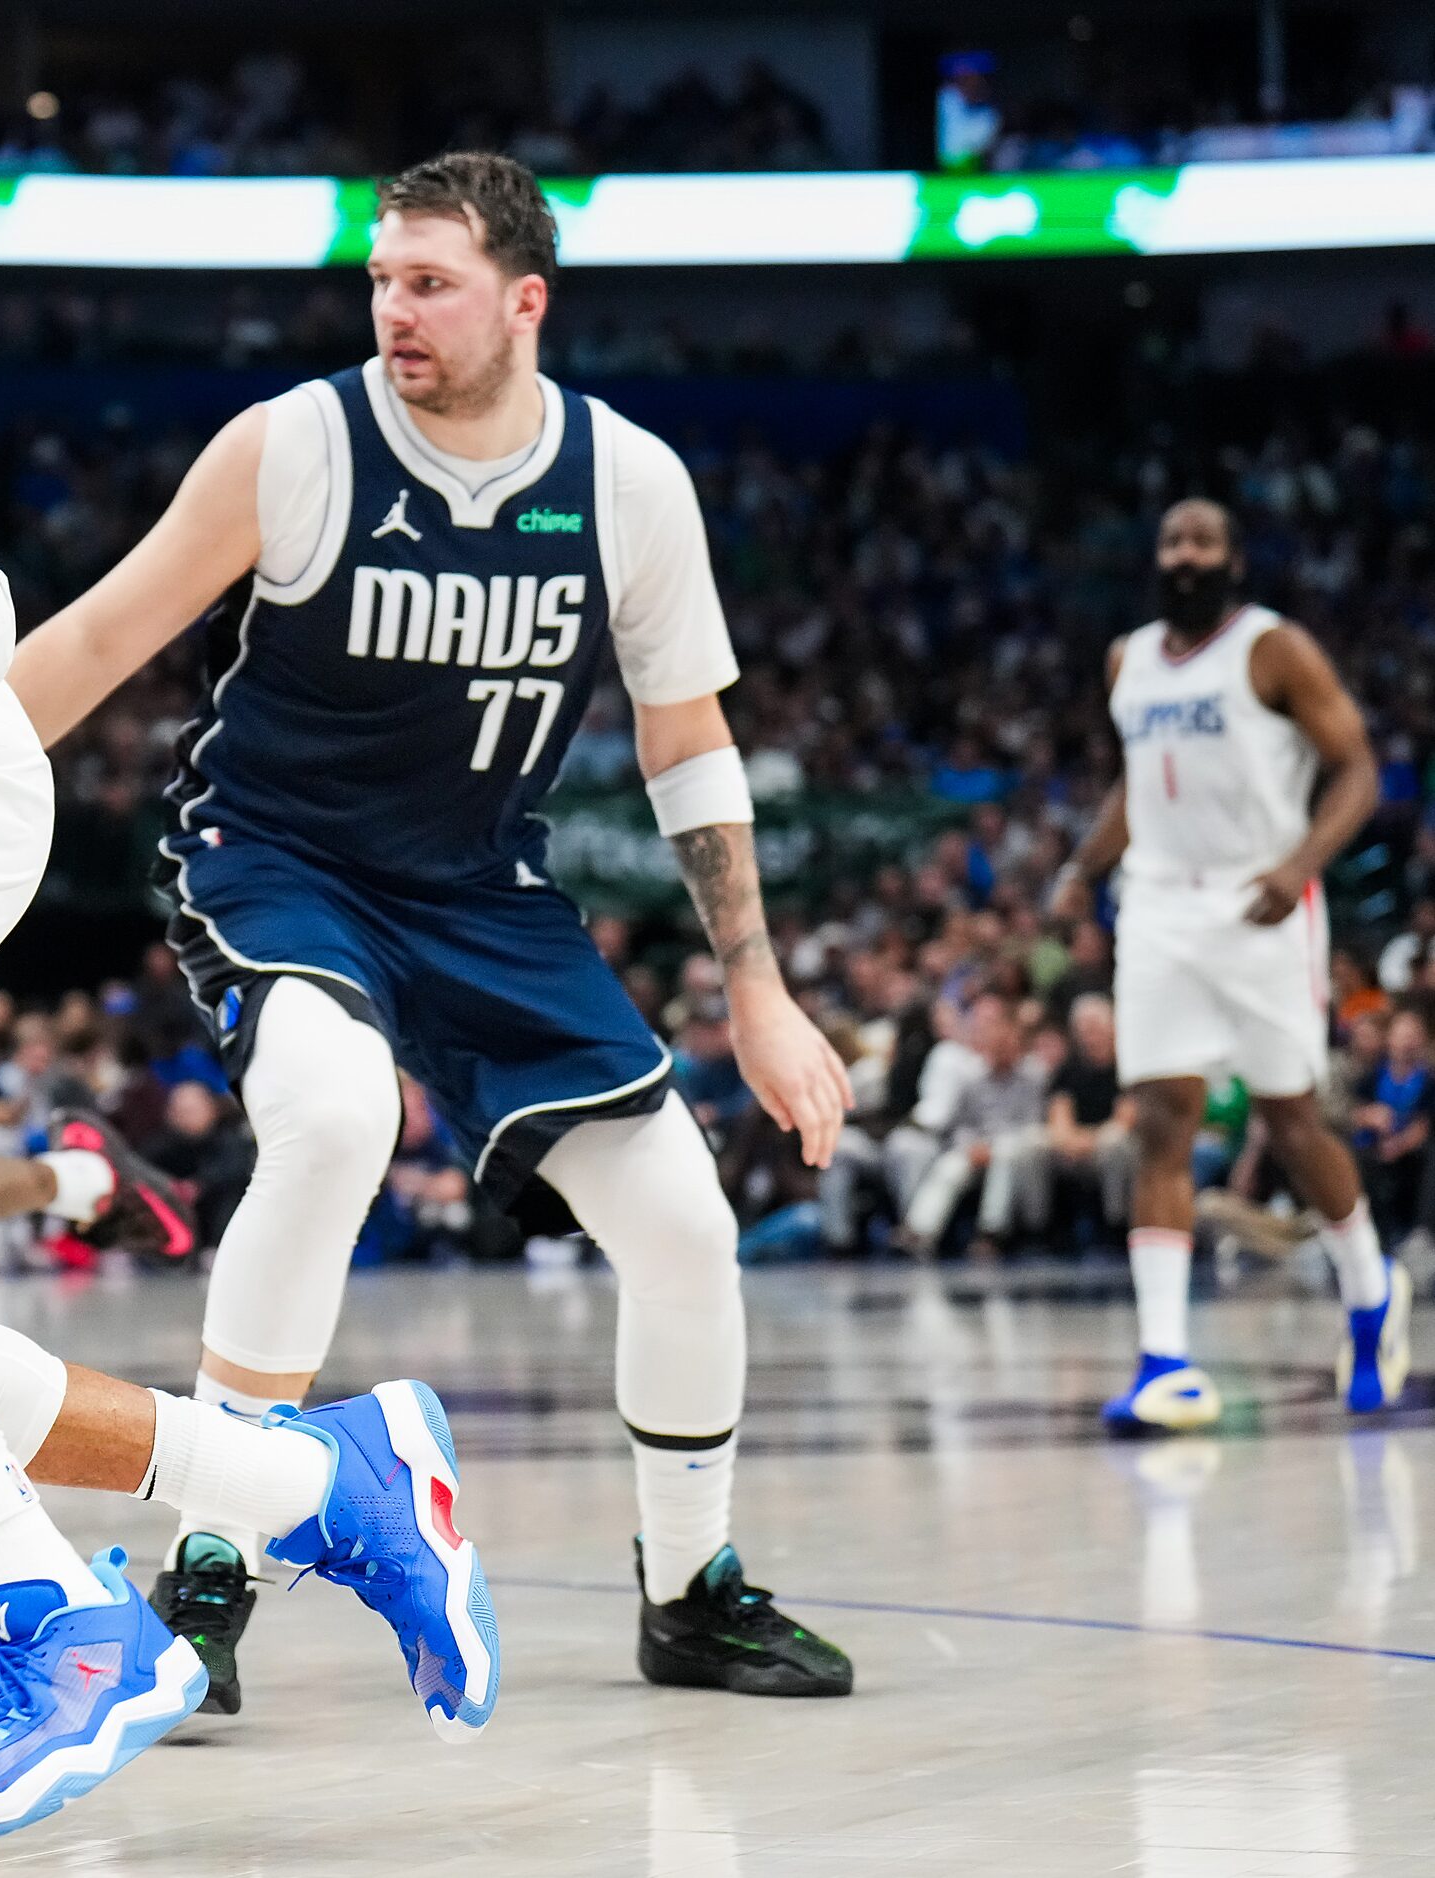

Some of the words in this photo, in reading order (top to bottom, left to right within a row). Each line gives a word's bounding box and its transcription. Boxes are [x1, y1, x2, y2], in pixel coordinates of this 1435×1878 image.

[517, 508, 583, 533] chime
[347, 566, 586, 668] MAVS
[467, 677, 564, 776] 77
